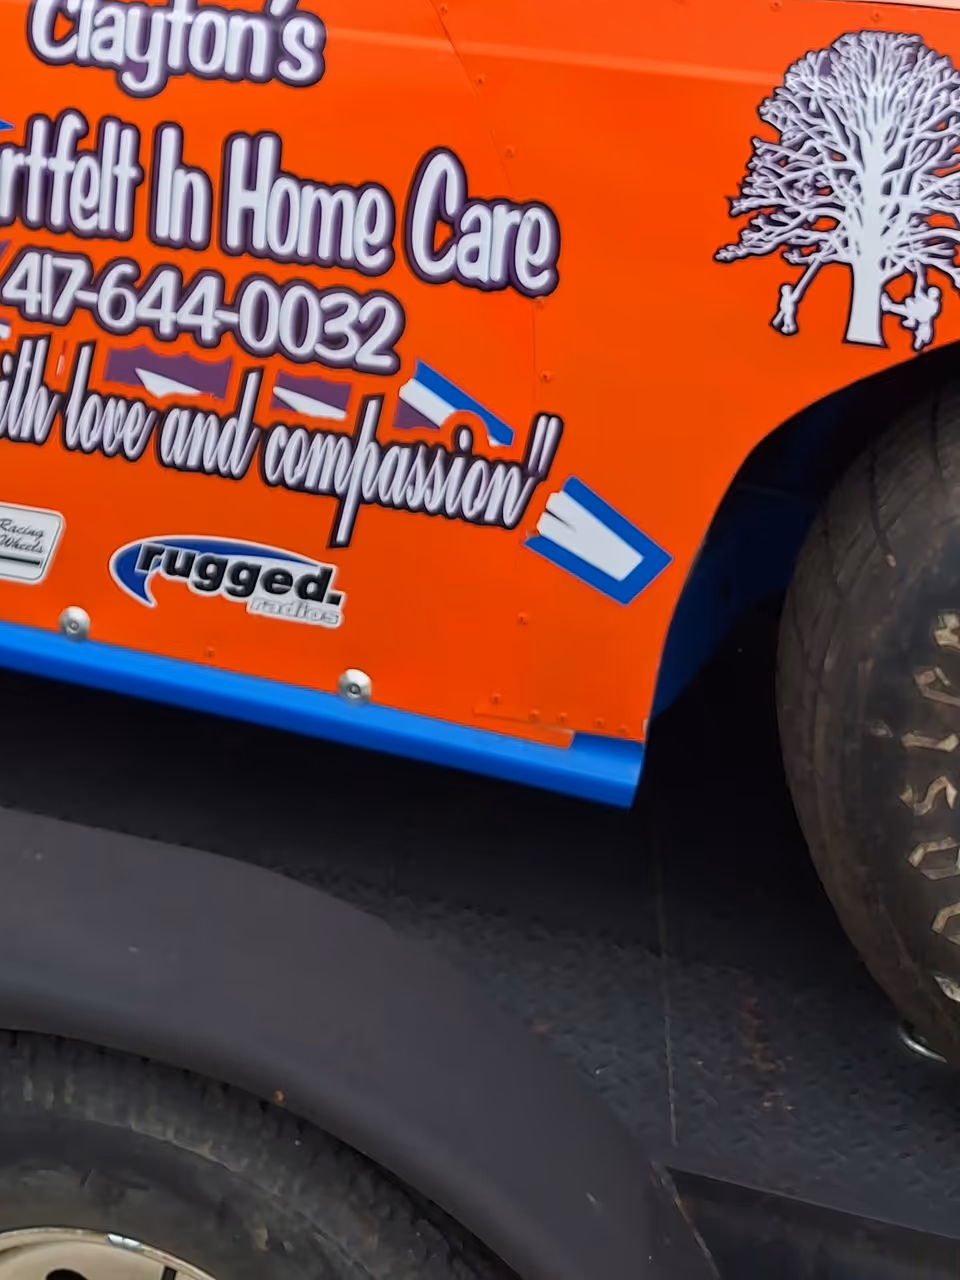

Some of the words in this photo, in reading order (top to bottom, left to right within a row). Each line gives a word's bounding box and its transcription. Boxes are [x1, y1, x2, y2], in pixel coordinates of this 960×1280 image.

[148, 122, 213, 251] In
[220, 131, 396, 277] Home
[405, 146, 560, 298] Care
[64, 339, 157, 461] love
[157, 366, 262, 480] and
[260, 394, 563, 549] compassion"
[248, 597, 342, 627] radios
